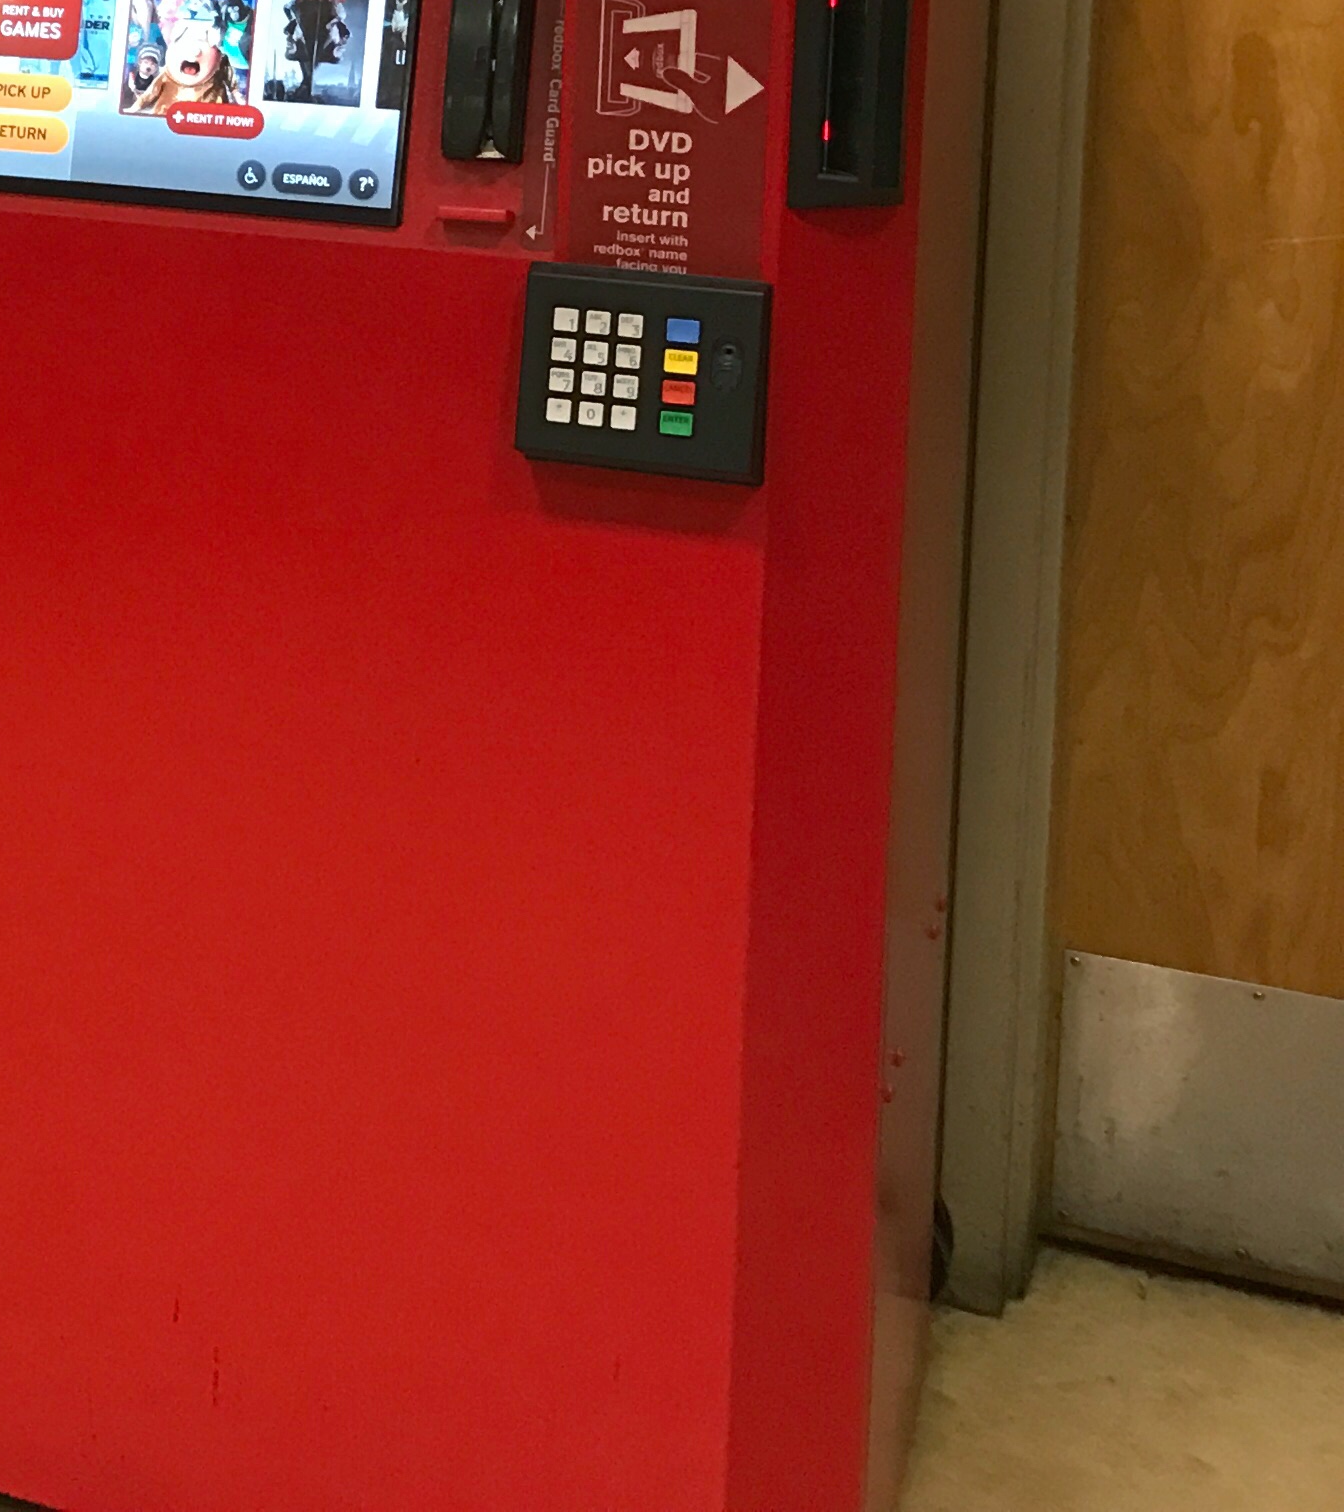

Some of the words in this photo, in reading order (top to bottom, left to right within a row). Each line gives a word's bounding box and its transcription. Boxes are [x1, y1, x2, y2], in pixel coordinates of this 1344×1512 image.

[2, 5, 29, 17] RENT
[32, 7, 40, 17] &
[42, 7, 64, 18] BUY
[0, 20, 62, 40] GAMES
[31, 84, 51, 99] UP
[628, 128, 692, 154] DVD
[587, 153, 645, 179] pick
[655, 162, 690, 184] up
[282, 171, 330, 187] ESPAÑOL
[648, 187, 690, 204] and
[602, 205, 688, 228] return
